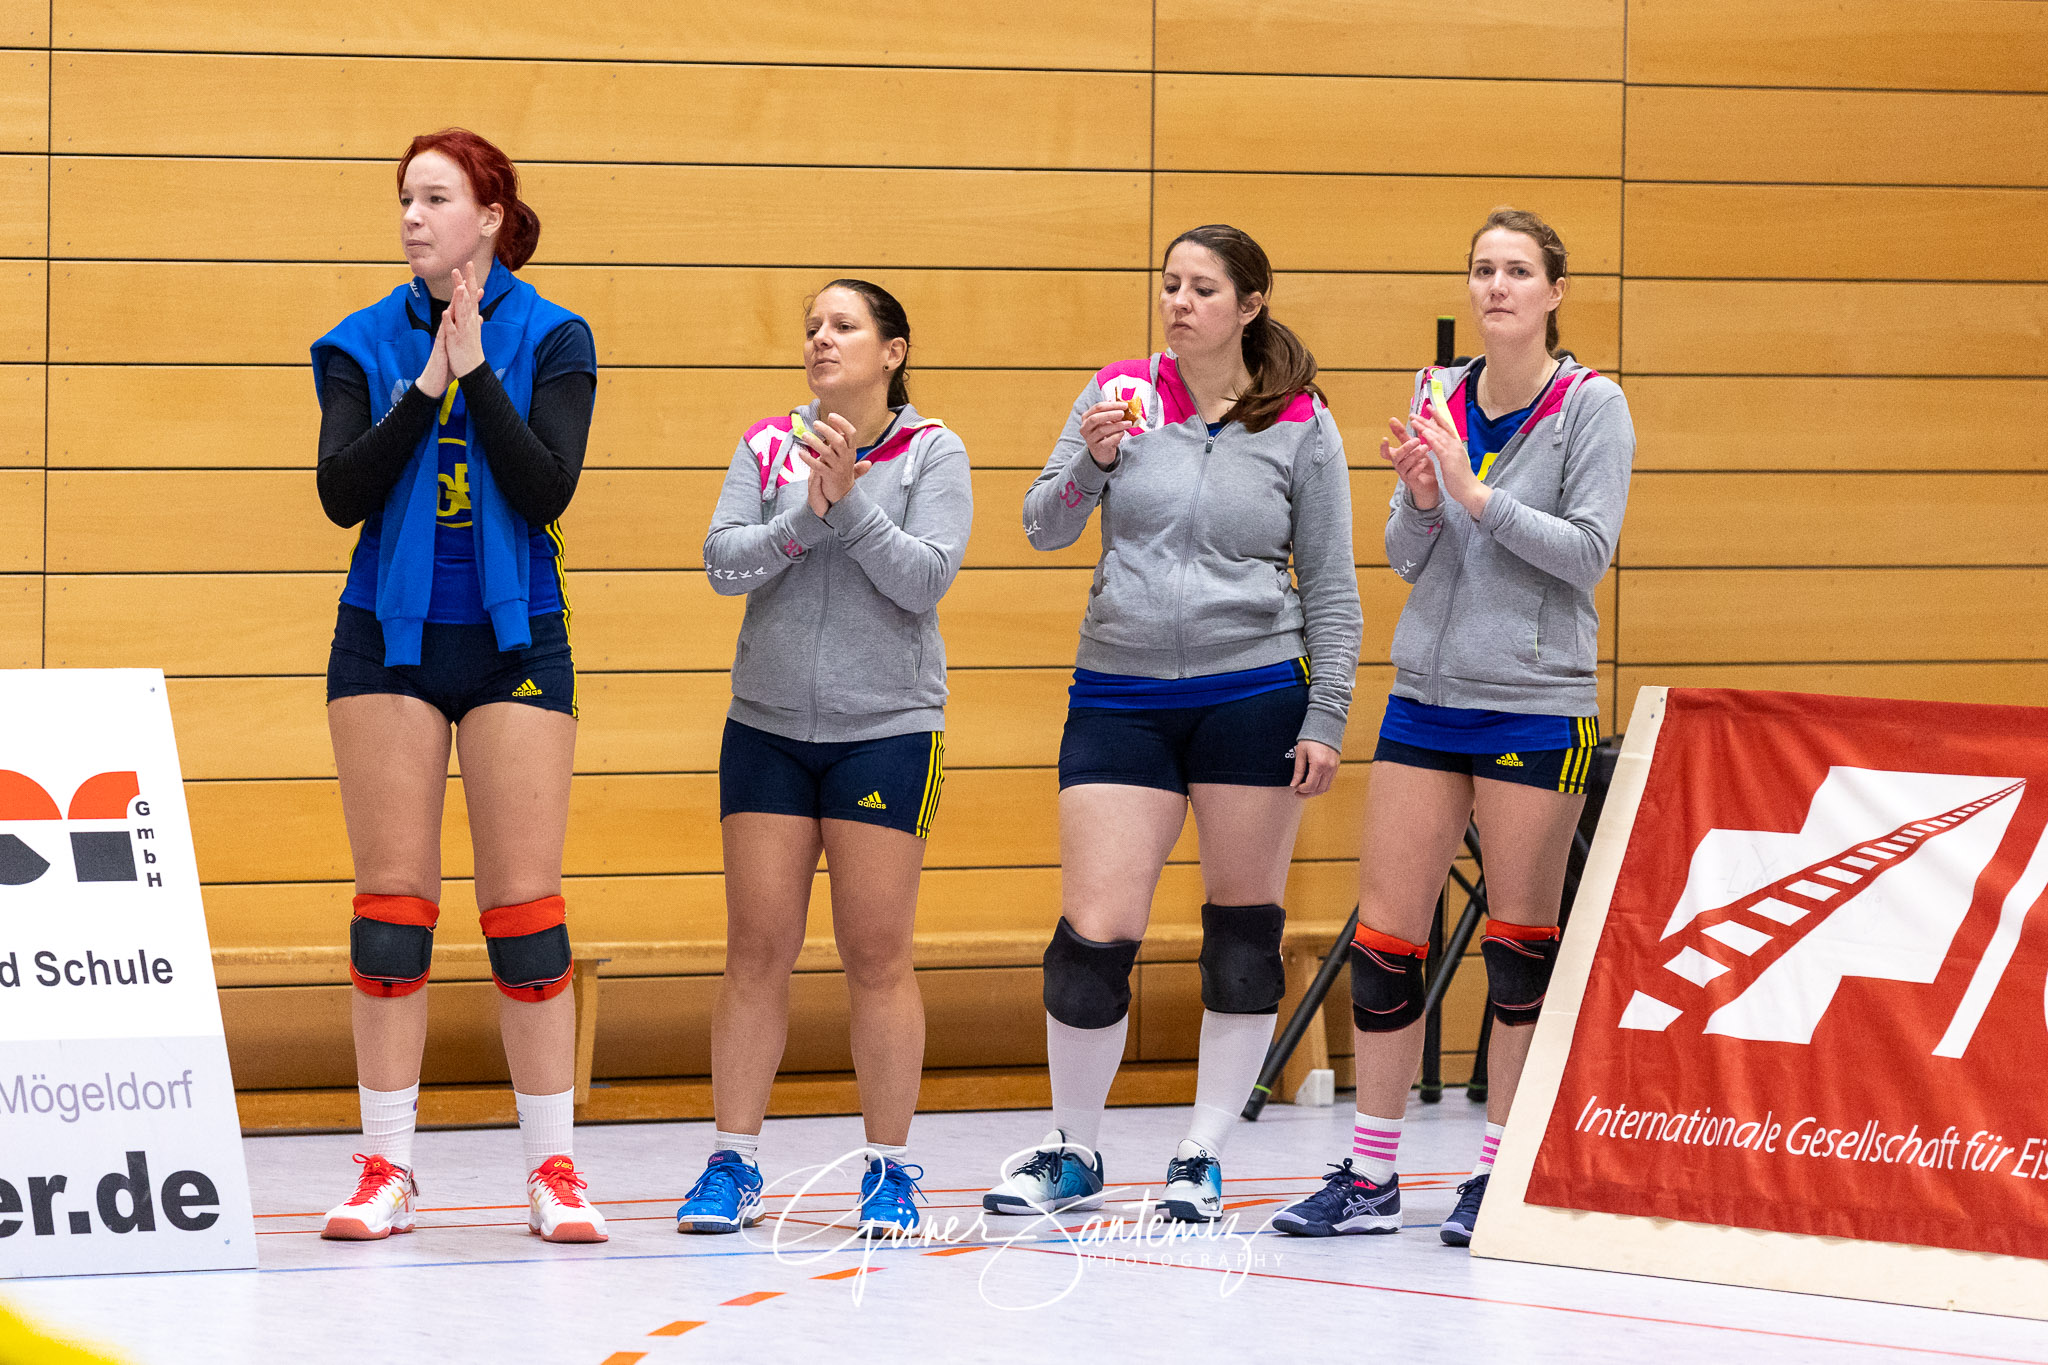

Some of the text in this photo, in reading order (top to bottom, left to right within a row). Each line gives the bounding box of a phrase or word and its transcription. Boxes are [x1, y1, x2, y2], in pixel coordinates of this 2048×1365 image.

[511, 688, 543, 697] adidas
[1495, 758, 1524, 767] adidas
[857, 800, 887, 810] adidas
[135, 801, 162, 887] GmbH
[34, 949, 173, 987] Schule
[0, 1069, 193, 1123] Mögeldorf
[1575, 1095, 1782, 1153] Internationale
[1785, 1116, 1961, 1170] Gesellschaft
[1961, 1130, 2015, 1172] für
[0, 1150, 220, 1239] er.de
